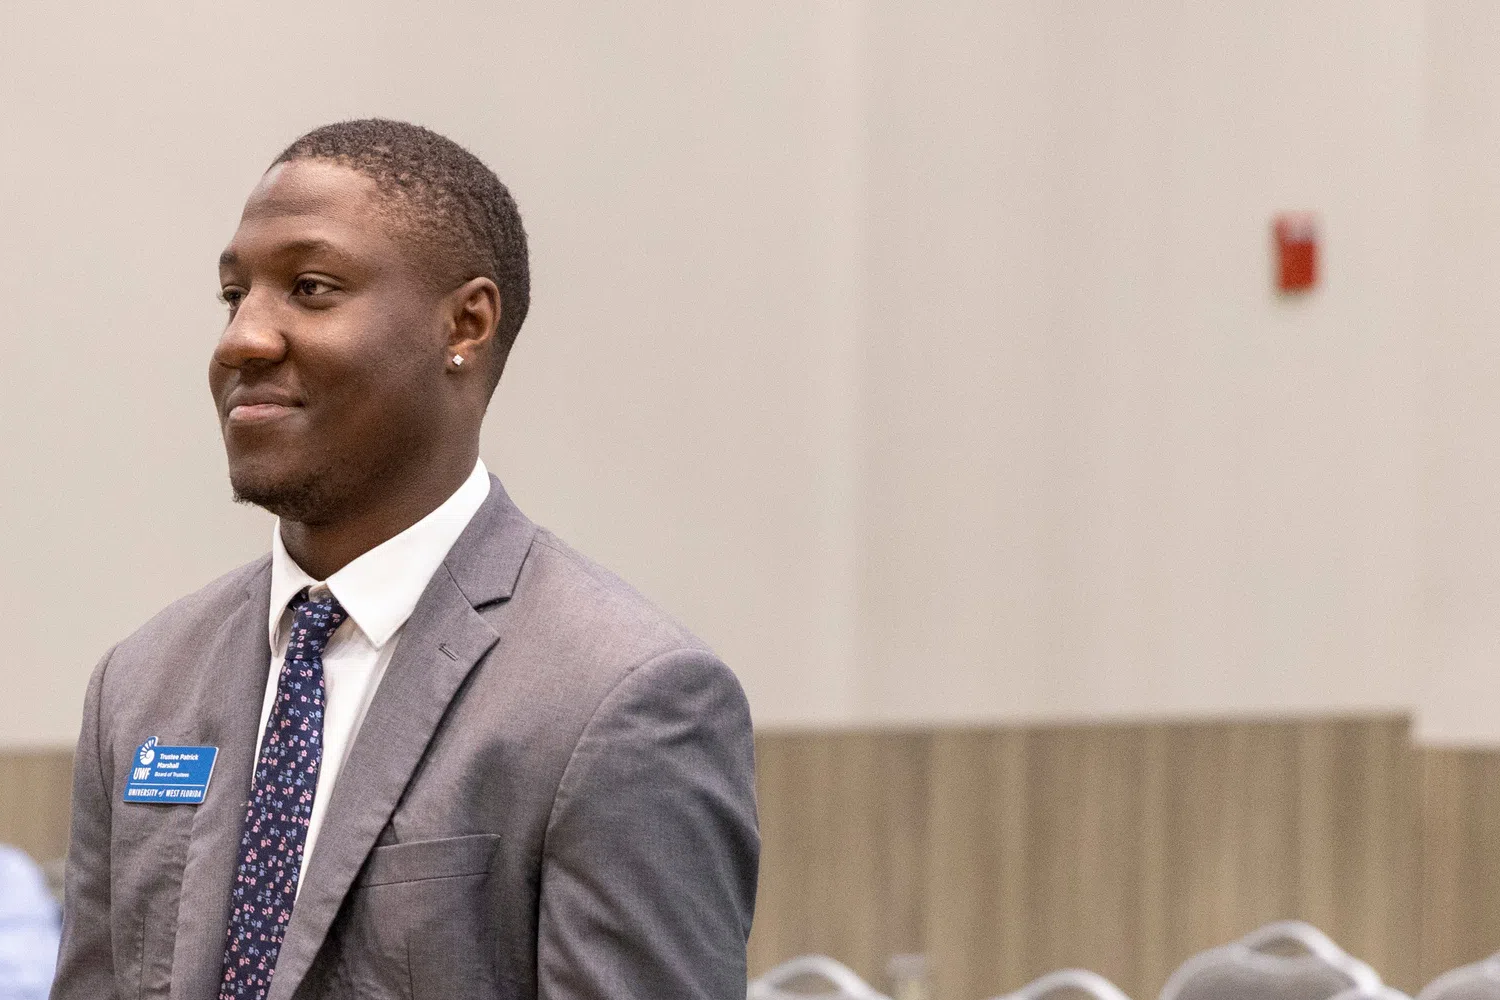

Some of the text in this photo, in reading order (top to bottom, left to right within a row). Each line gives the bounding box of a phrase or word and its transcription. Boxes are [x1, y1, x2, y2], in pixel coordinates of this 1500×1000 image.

[180, 753, 199, 761] Patrick
[133, 768, 151, 780] UWF
[128, 788, 158, 797] UNIVERSITY
[158, 789, 165, 797] of
[166, 789, 180, 797] WEST
